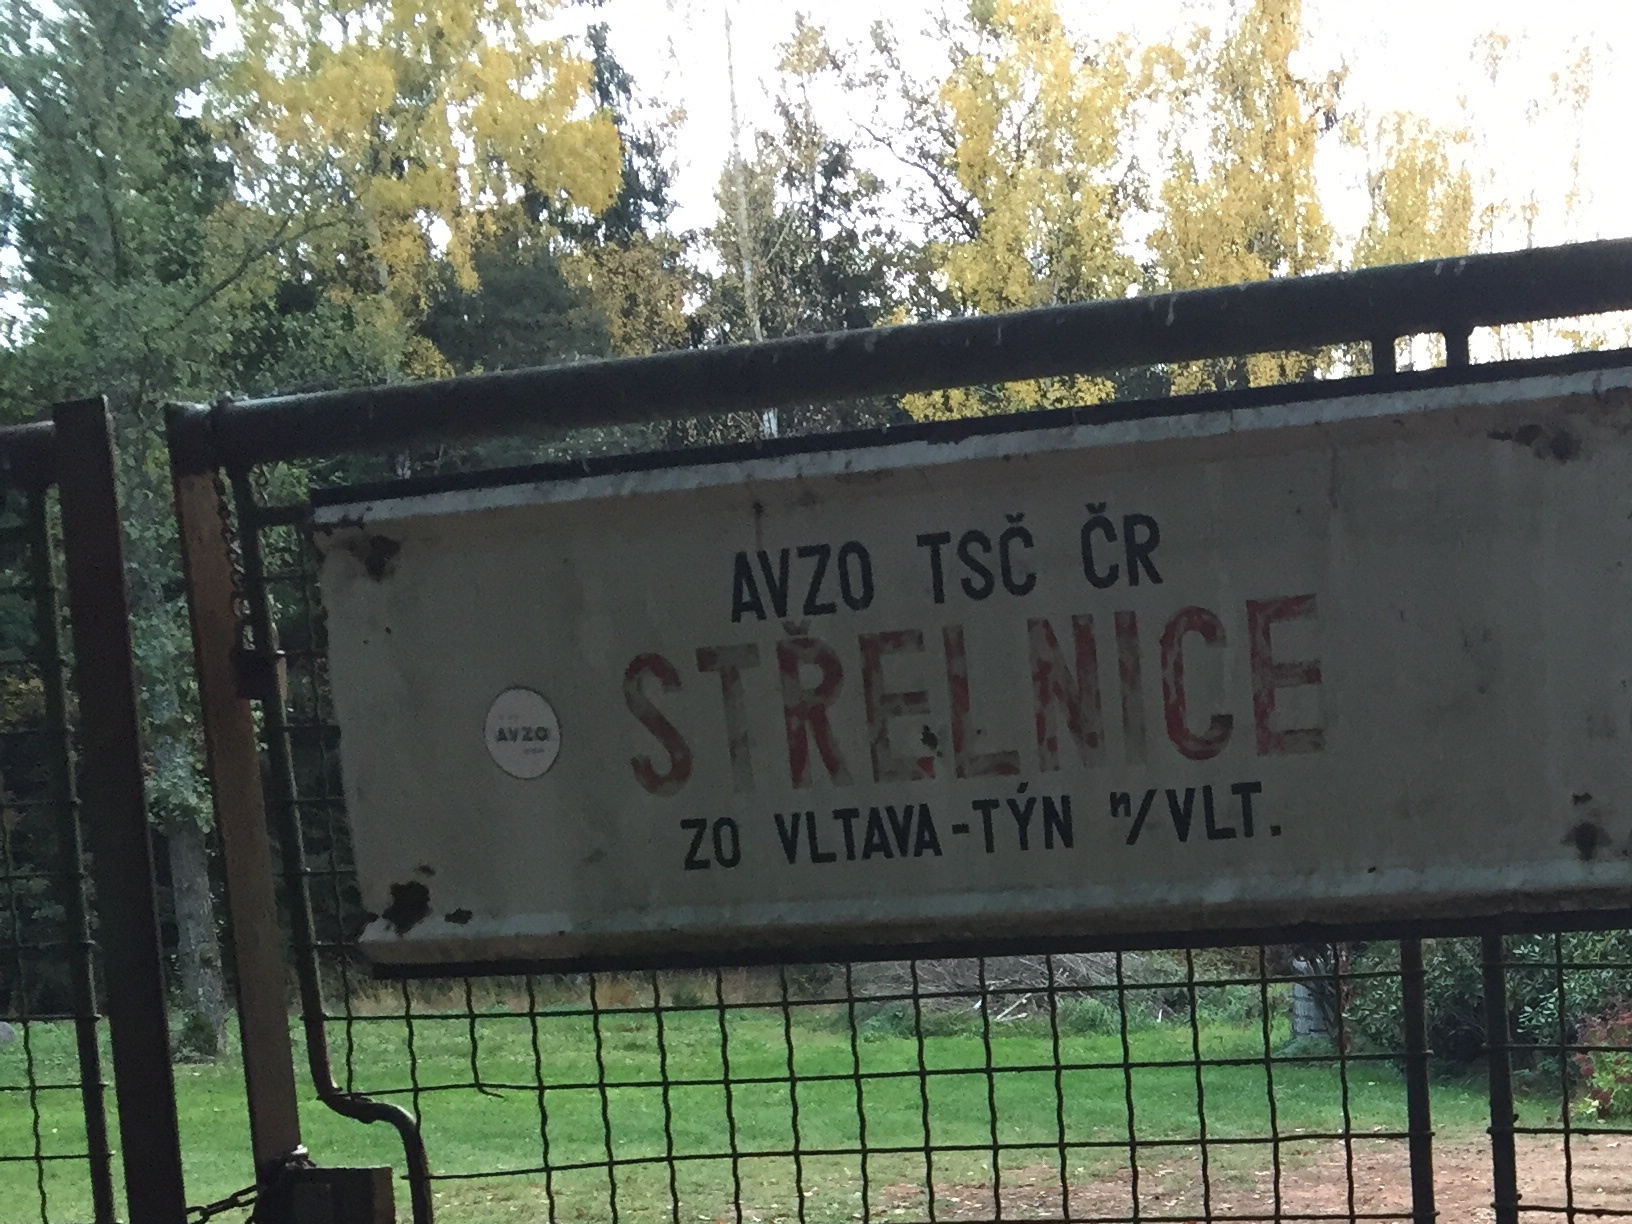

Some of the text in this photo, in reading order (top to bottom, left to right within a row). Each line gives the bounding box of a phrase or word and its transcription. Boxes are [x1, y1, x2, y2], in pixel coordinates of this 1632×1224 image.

[731, 502, 1164, 623] AVZO TSČ ČR
[496, 726, 548, 742] AVZO
[622, 593, 1327, 797] STŘELNICE
[680, 816, 742, 870] ZO
